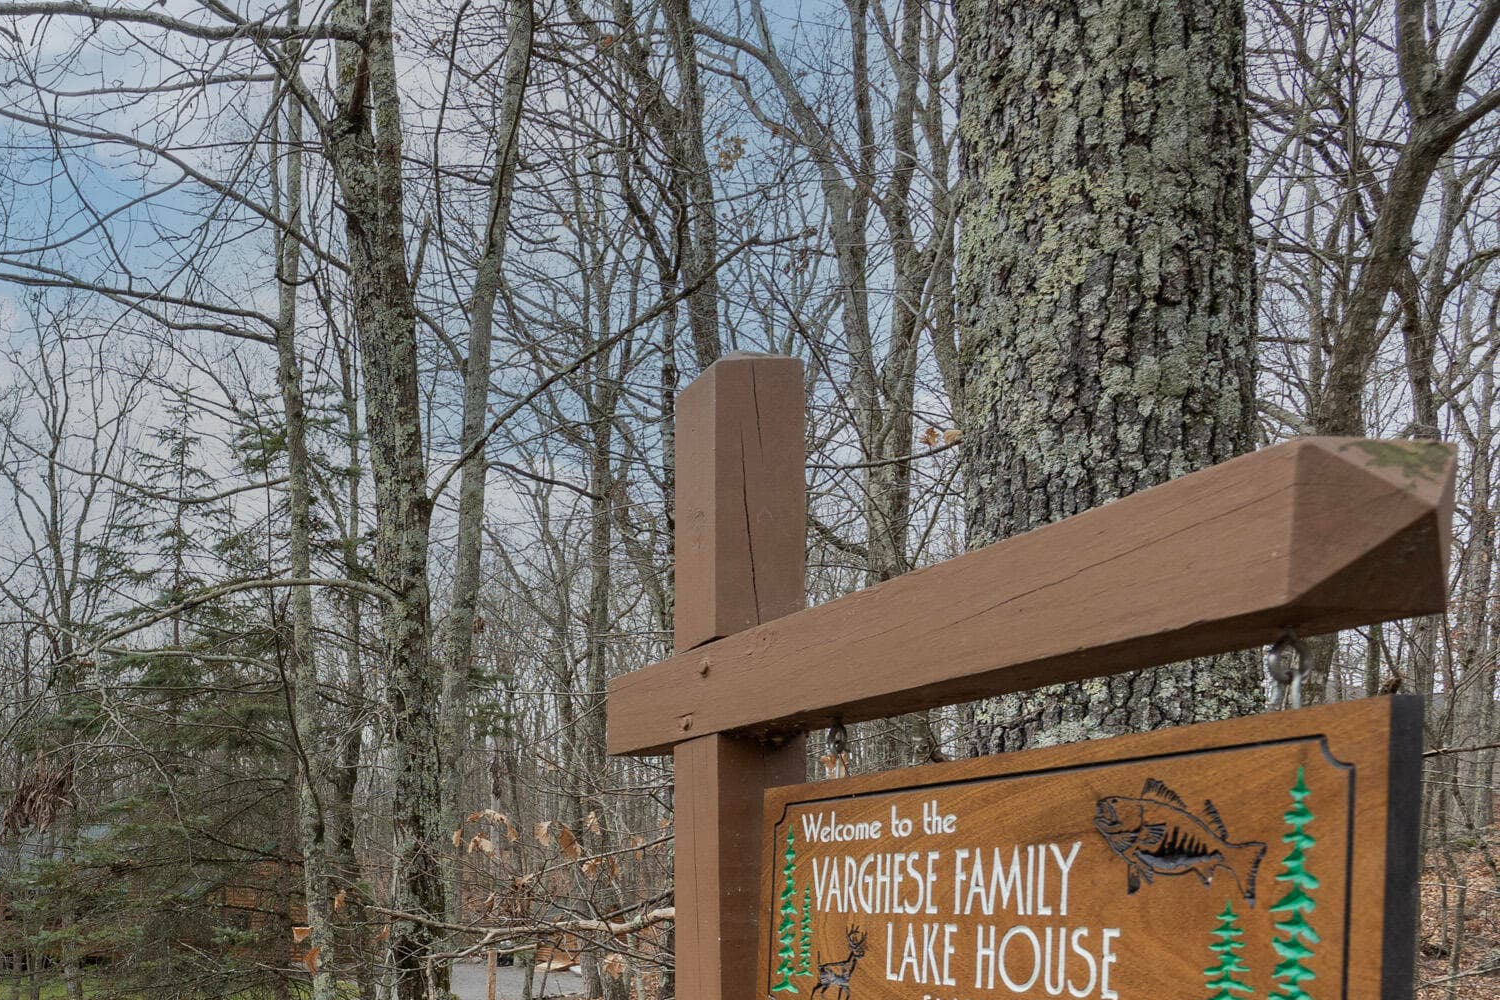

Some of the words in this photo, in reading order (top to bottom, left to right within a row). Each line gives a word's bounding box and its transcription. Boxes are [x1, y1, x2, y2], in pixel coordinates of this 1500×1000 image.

[801, 810, 882, 843] Welcome
[890, 804, 913, 838] to
[922, 799, 958, 836] the
[811, 850, 940, 916] VARGHESE
[953, 840, 1083, 917] FAMILY
[885, 921, 959, 987] LAKE
